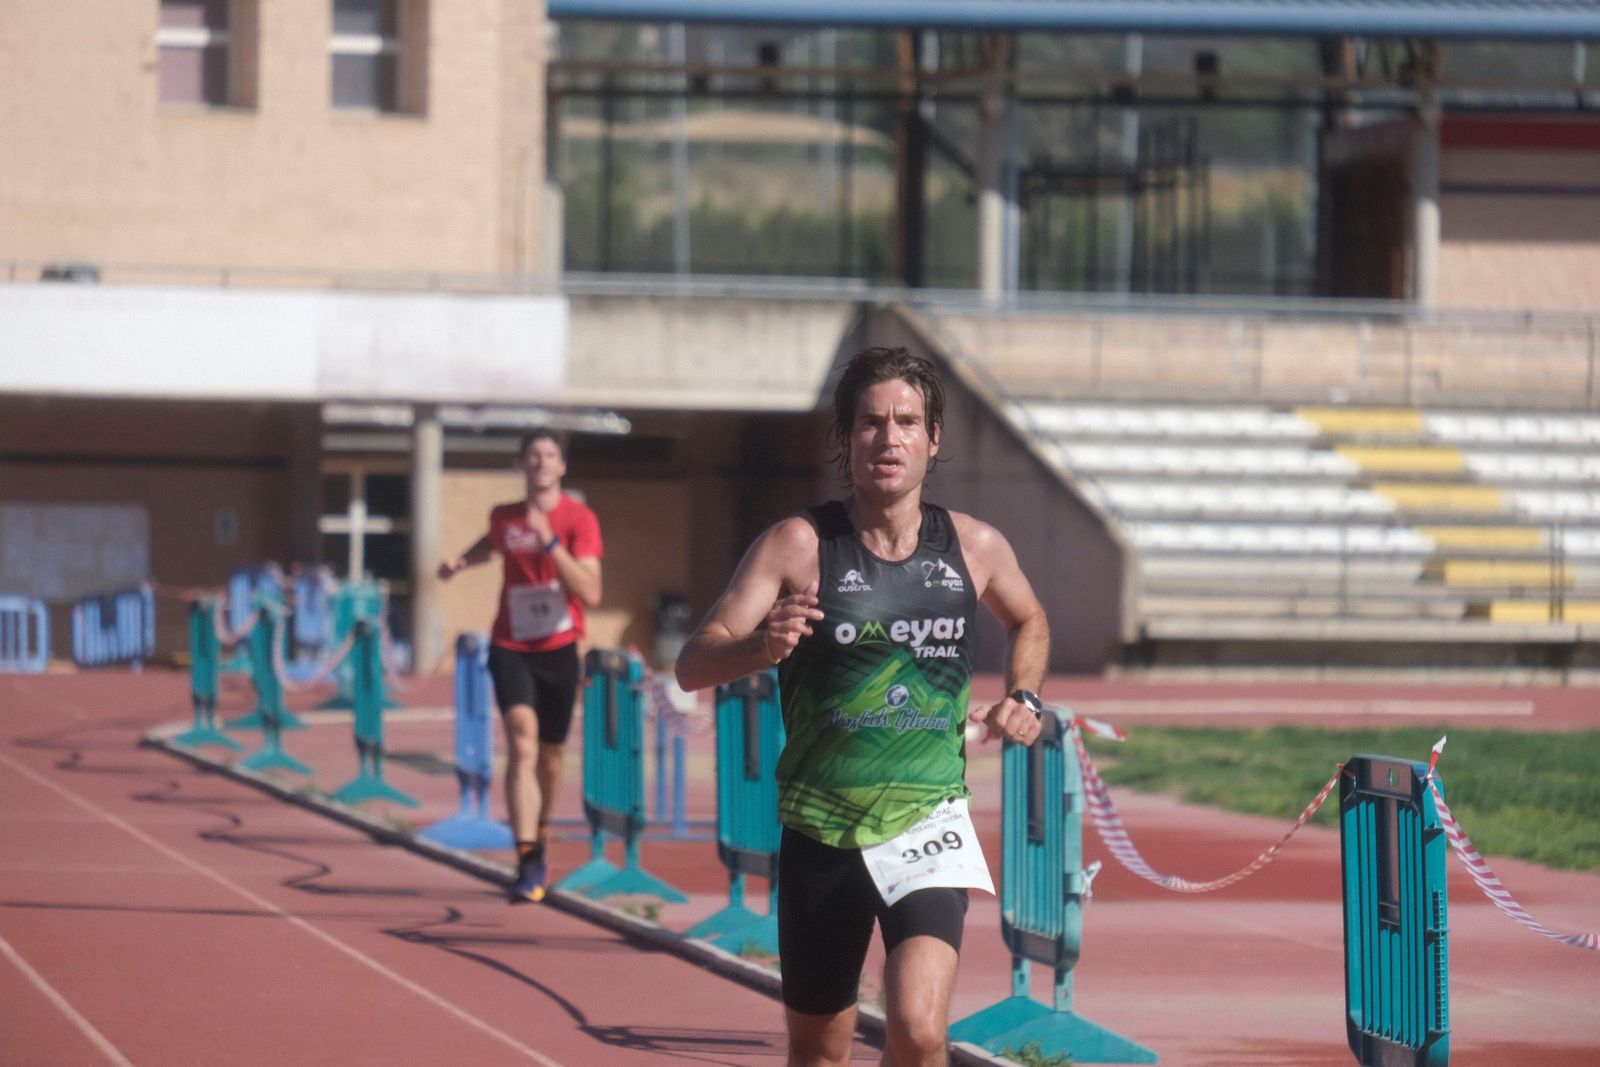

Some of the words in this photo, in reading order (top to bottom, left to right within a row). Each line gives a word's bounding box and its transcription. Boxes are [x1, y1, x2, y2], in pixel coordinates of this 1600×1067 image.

[838, 584, 873, 592] austral
[914, 646, 959, 658] TRAIL
[902, 830, 963, 864] 309
